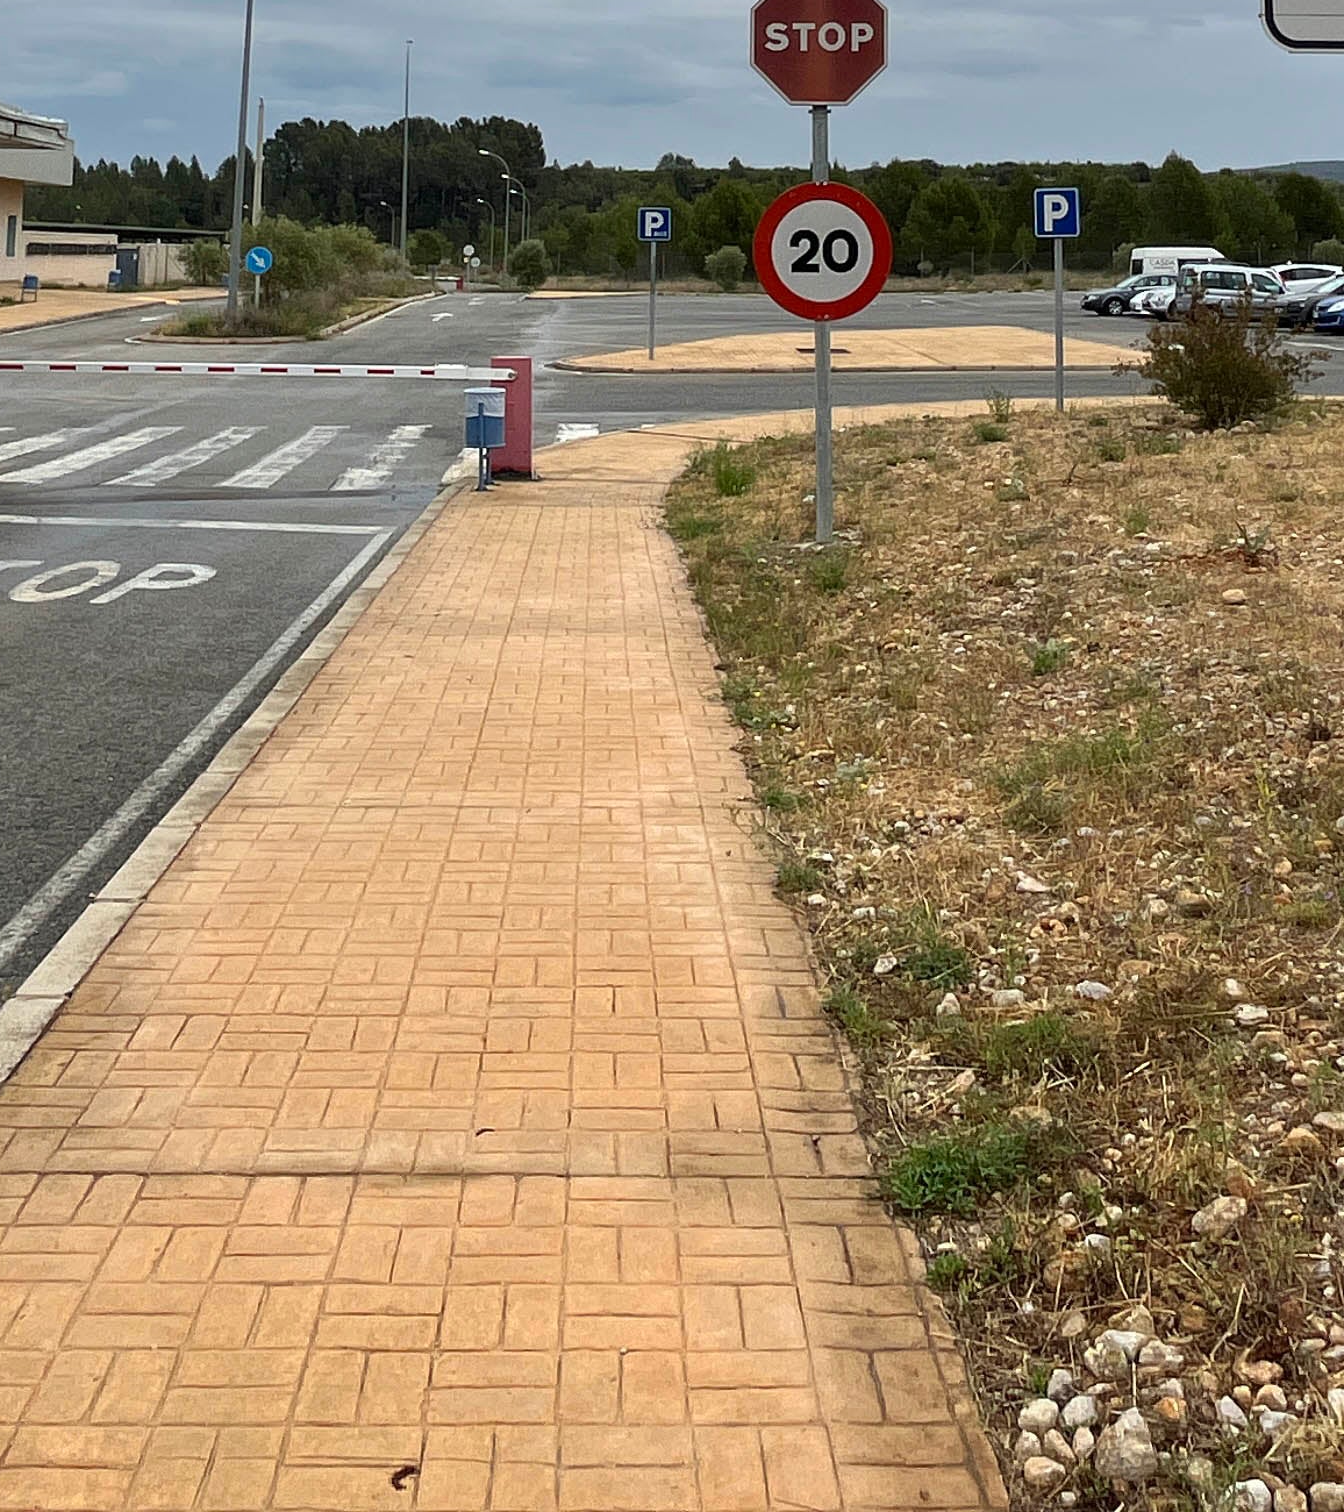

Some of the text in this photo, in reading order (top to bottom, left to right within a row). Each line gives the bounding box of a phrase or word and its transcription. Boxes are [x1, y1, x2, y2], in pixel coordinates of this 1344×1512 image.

[764, 21, 875, 53] STOP
[645, 211, 665, 237] P
[1043, 193, 1069, 232] P
[789, 229, 859, 273] 20
